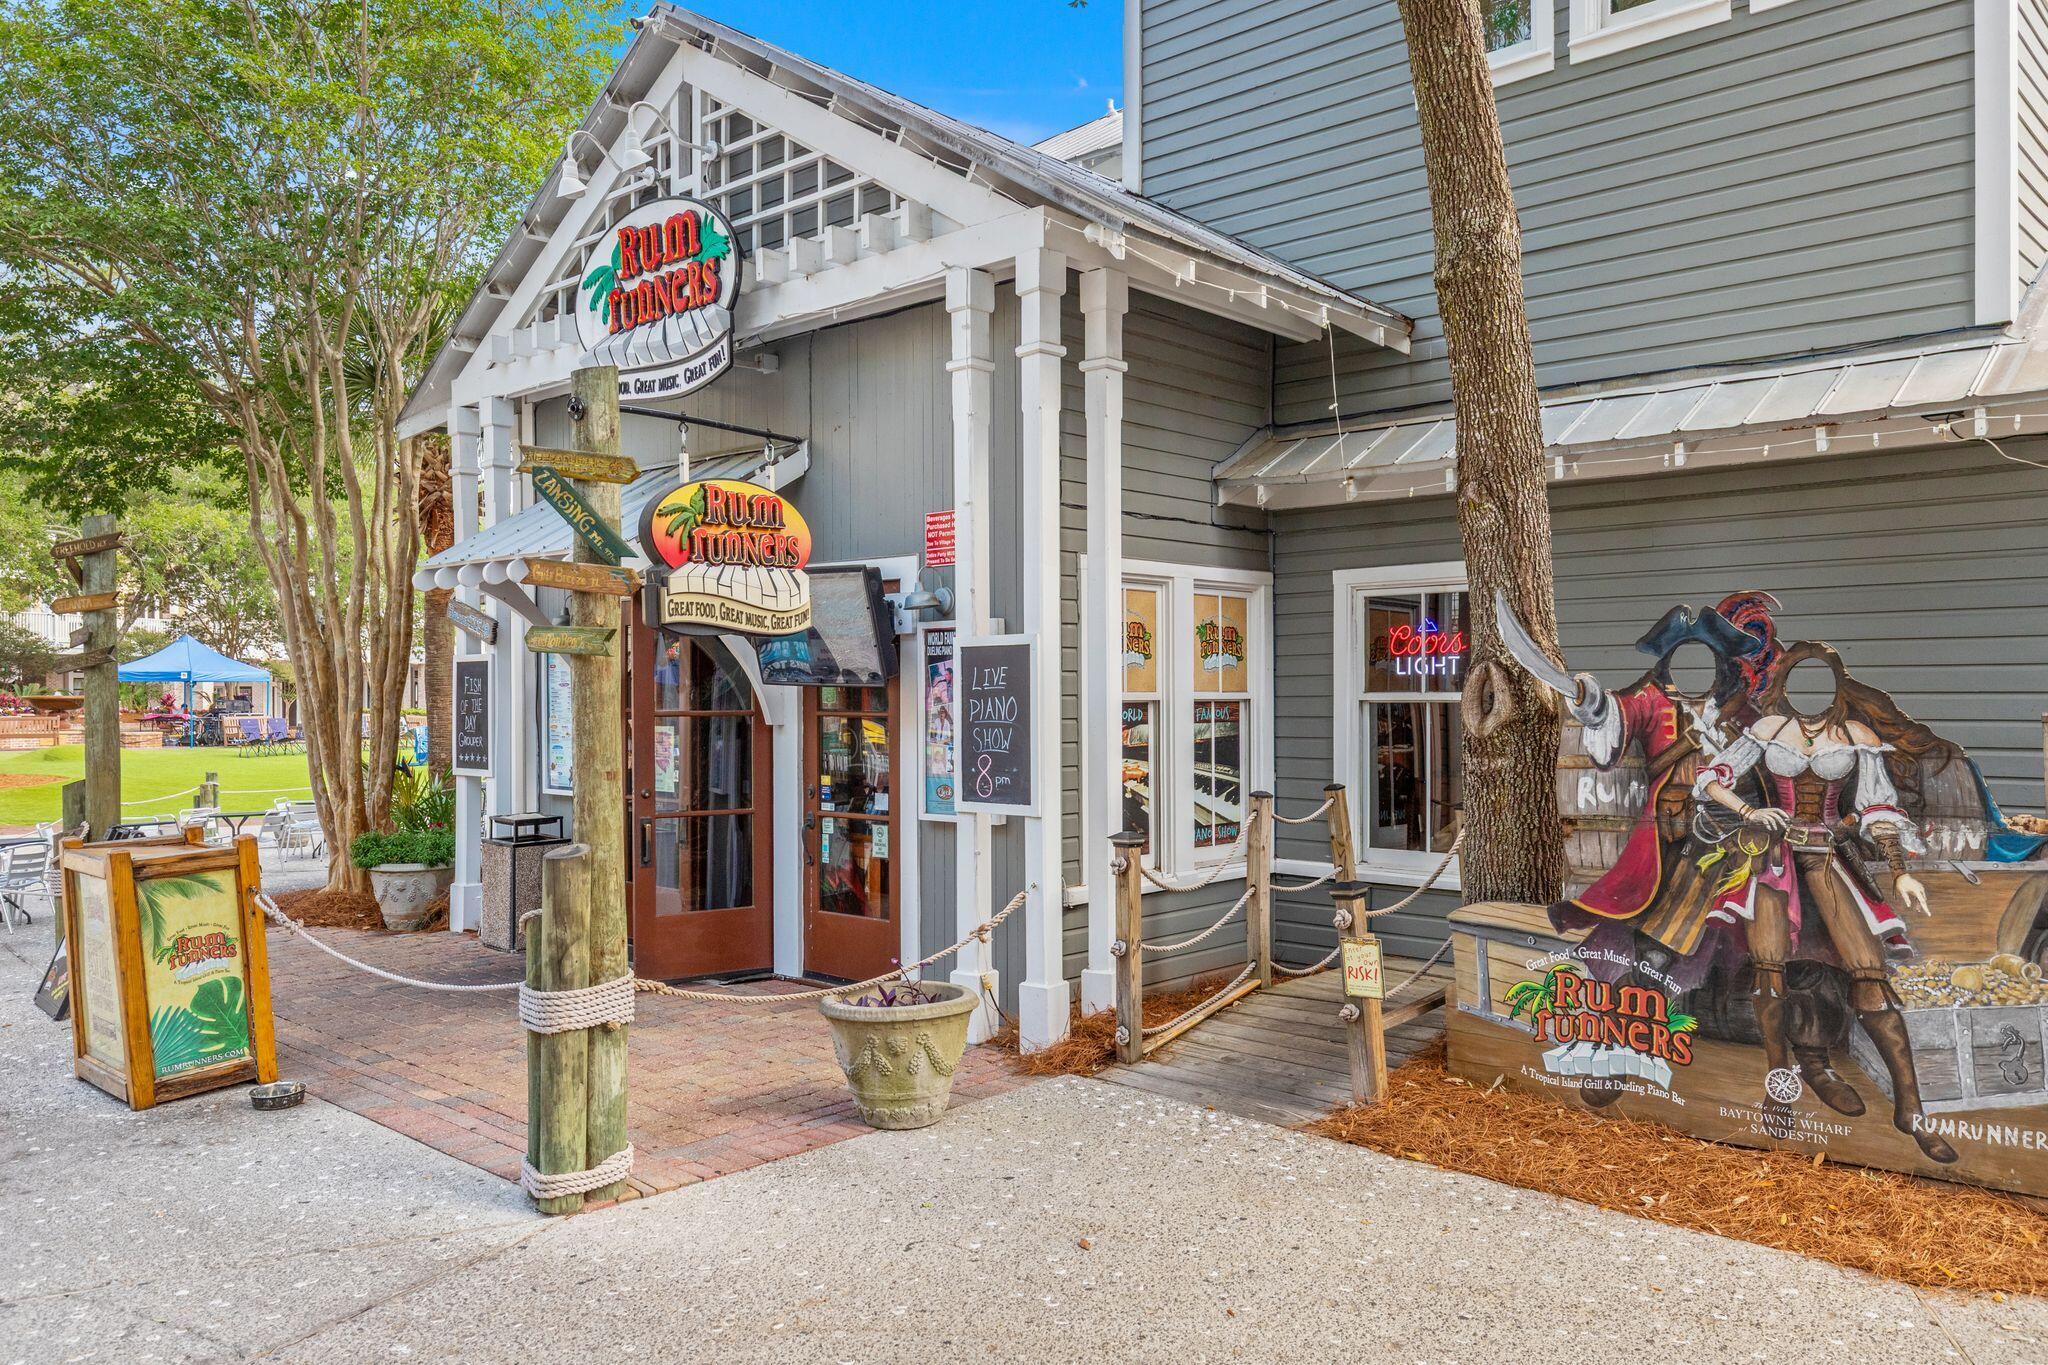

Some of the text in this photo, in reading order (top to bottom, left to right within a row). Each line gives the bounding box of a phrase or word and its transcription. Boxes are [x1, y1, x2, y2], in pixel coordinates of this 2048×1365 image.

[617, 209, 701, 280] Rum
[634, 378, 657, 395] GREAT
[684, 362, 708, 384] GREAT
[701, 483, 786, 529] Rum
[927, 522, 951, 530] Purchased
[55, 539, 96, 556] FREEHOLD
[667, 599, 694, 617] GREAT
[695, 603, 718, 622] FOOD,
[719, 602, 745, 625] GREAT
[745, 612, 770, 631] MUSIC,
[771, 614, 793, 631] GREAT
[927, 632, 943, 645] WORLD
[1389, 624, 1467, 655] Coors
[927, 645, 941, 656] DUELING
[1396, 656, 1460, 675] LIGHT
[464, 676, 482, 693] FISH
[972, 667, 1008, 690] LIVE
[460, 698, 482, 713] OF THE
[970, 696, 1018, 722] PIANO
[1121, 708, 1143, 721] ORLD
[465, 715, 477, 730] DAY
[972, 727, 1012, 752] SHOW
[976, 754, 993, 798] 8
[995, 775, 1011, 789] pm
[1218, 825, 1238, 839] SHOW
[176, 931, 227, 952] Rum
[1347, 965, 1378, 984] RISK!
[1525, 946, 1682, 995] Great Food Great Music Great Fun
[1553, 970, 1670, 1023] Rum
[1520, 1064, 1686, 1106] A Tropical Island Grill & Dueling Piano Bar
[1719, 1106, 1853, 1137] BAYTOWNE WHARF
[1772, 1105, 1803, 1117] Village
[1750, 1123, 1829, 1145] SANDESTIN
